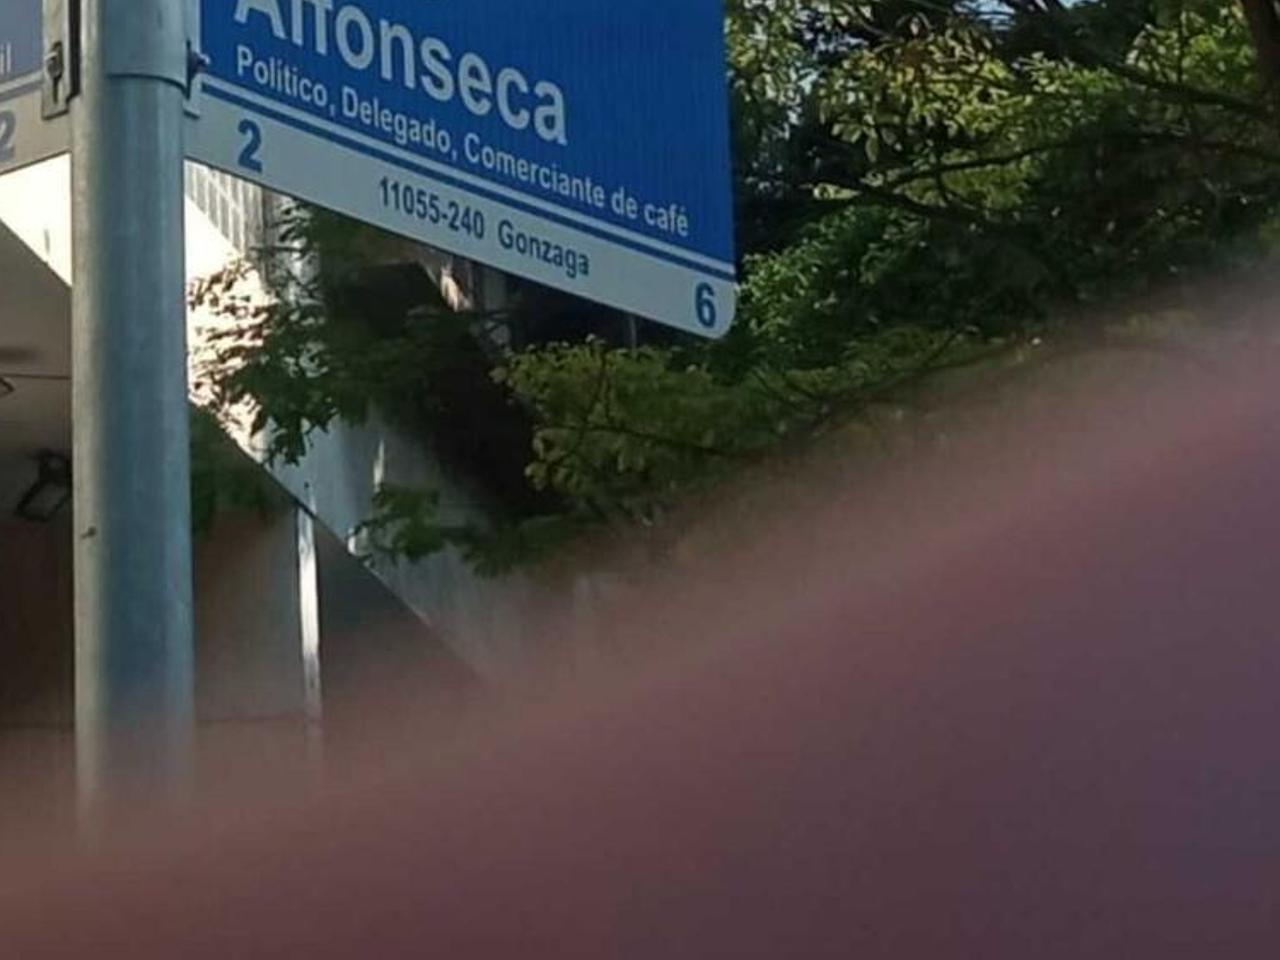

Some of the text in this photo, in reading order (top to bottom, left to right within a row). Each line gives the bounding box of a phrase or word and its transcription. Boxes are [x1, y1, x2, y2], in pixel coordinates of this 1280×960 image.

[237, 118, 263, 174] 2
[342, 86, 458, 161] Delegado,
[464, 132, 605, 208] Comerciante
[611, 186, 638, 219] de
[644, 203, 689, 237] café
[380, 176, 590, 279] 11055-240 Gonzaga
[695, 282, 717, 328] 6
